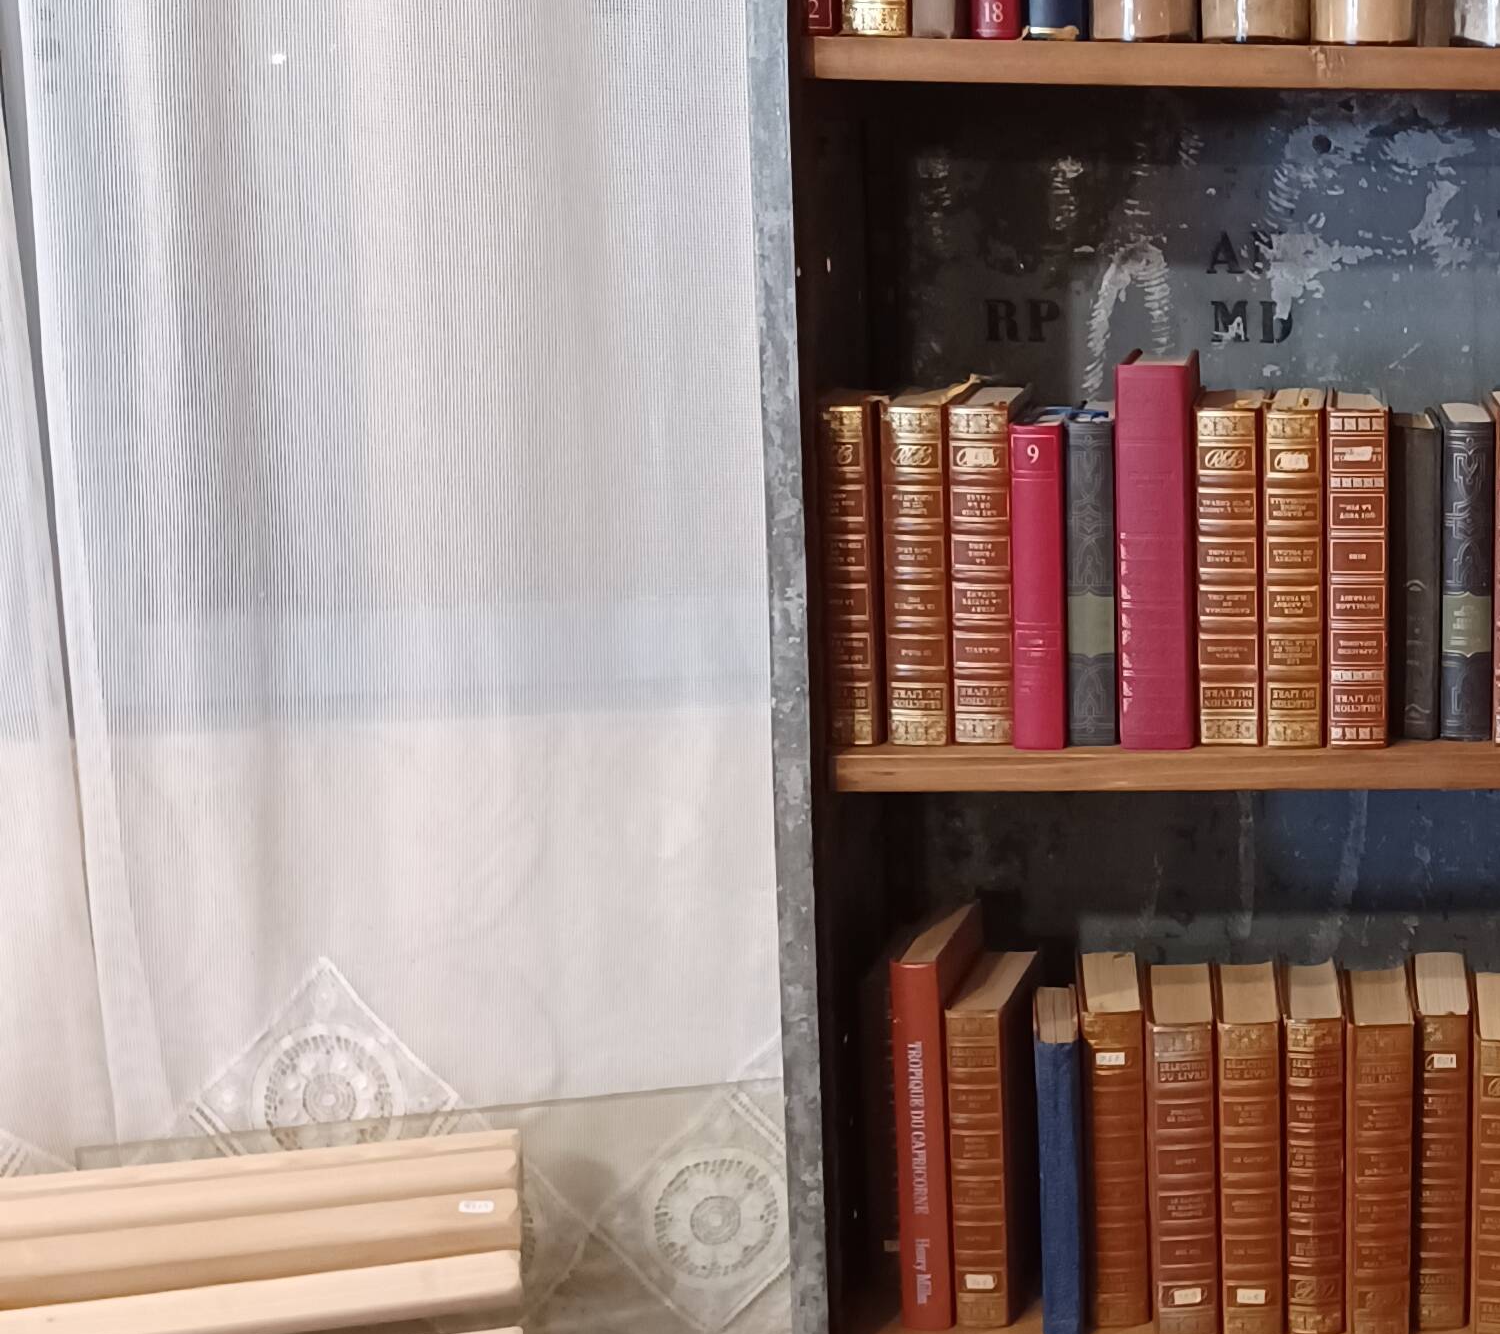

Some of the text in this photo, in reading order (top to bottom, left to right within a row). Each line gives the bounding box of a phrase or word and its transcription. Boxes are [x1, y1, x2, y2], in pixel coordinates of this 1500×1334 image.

[983, 1, 1004, 23] 18
[1026, 445, 1040, 464] 9
[892, 688, 942, 698] DU LIVRE
[959, 687, 989, 696] LIVRE
[1204, 689, 1253, 698] DU LIVRE
[1271, 689, 1315, 698] DU LIVRE
[1335, 694, 1381, 703] DU LIVRE
[1159, 1072, 1174, 1082] DU
[906, 1041, 929, 1216] TROPIQUE DU CAPRICORNE
[913, 1238, 932, 1306] Henry Miller
